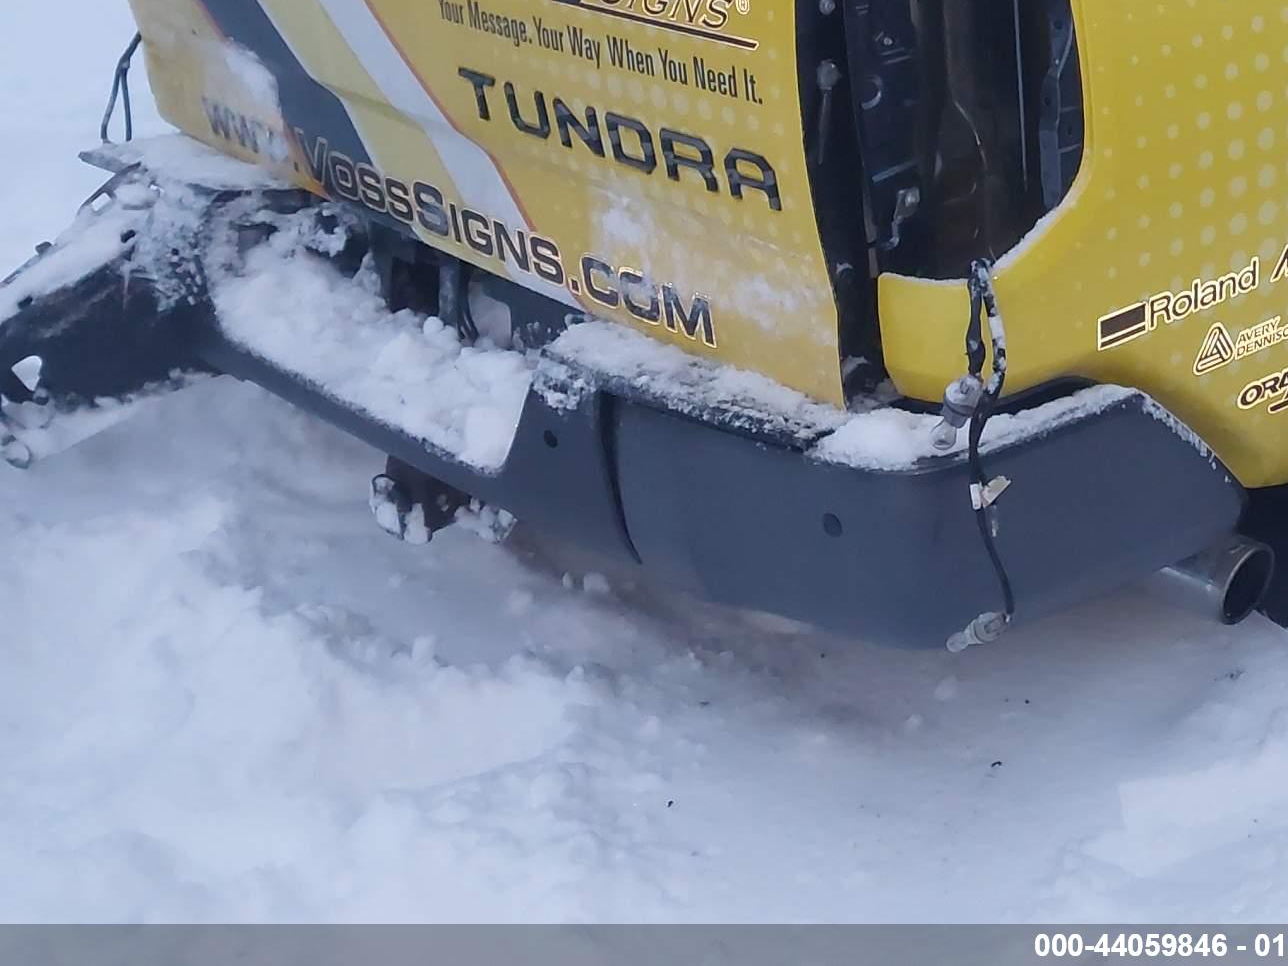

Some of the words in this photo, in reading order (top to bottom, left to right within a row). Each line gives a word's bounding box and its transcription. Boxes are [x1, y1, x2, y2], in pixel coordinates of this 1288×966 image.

[532, 15, 565, 54] Your
[566, 25, 602, 68] Way
[606, 35, 656, 78] When
[657, 47, 689, 86] You
[692, 55, 740, 99] Need
[742, 68, 764, 105] It.
[457, 66, 783, 212] TUNDRA
[1149, 256, 1260, 330] Roland
[1238, 316, 1281, 345] AVERY
